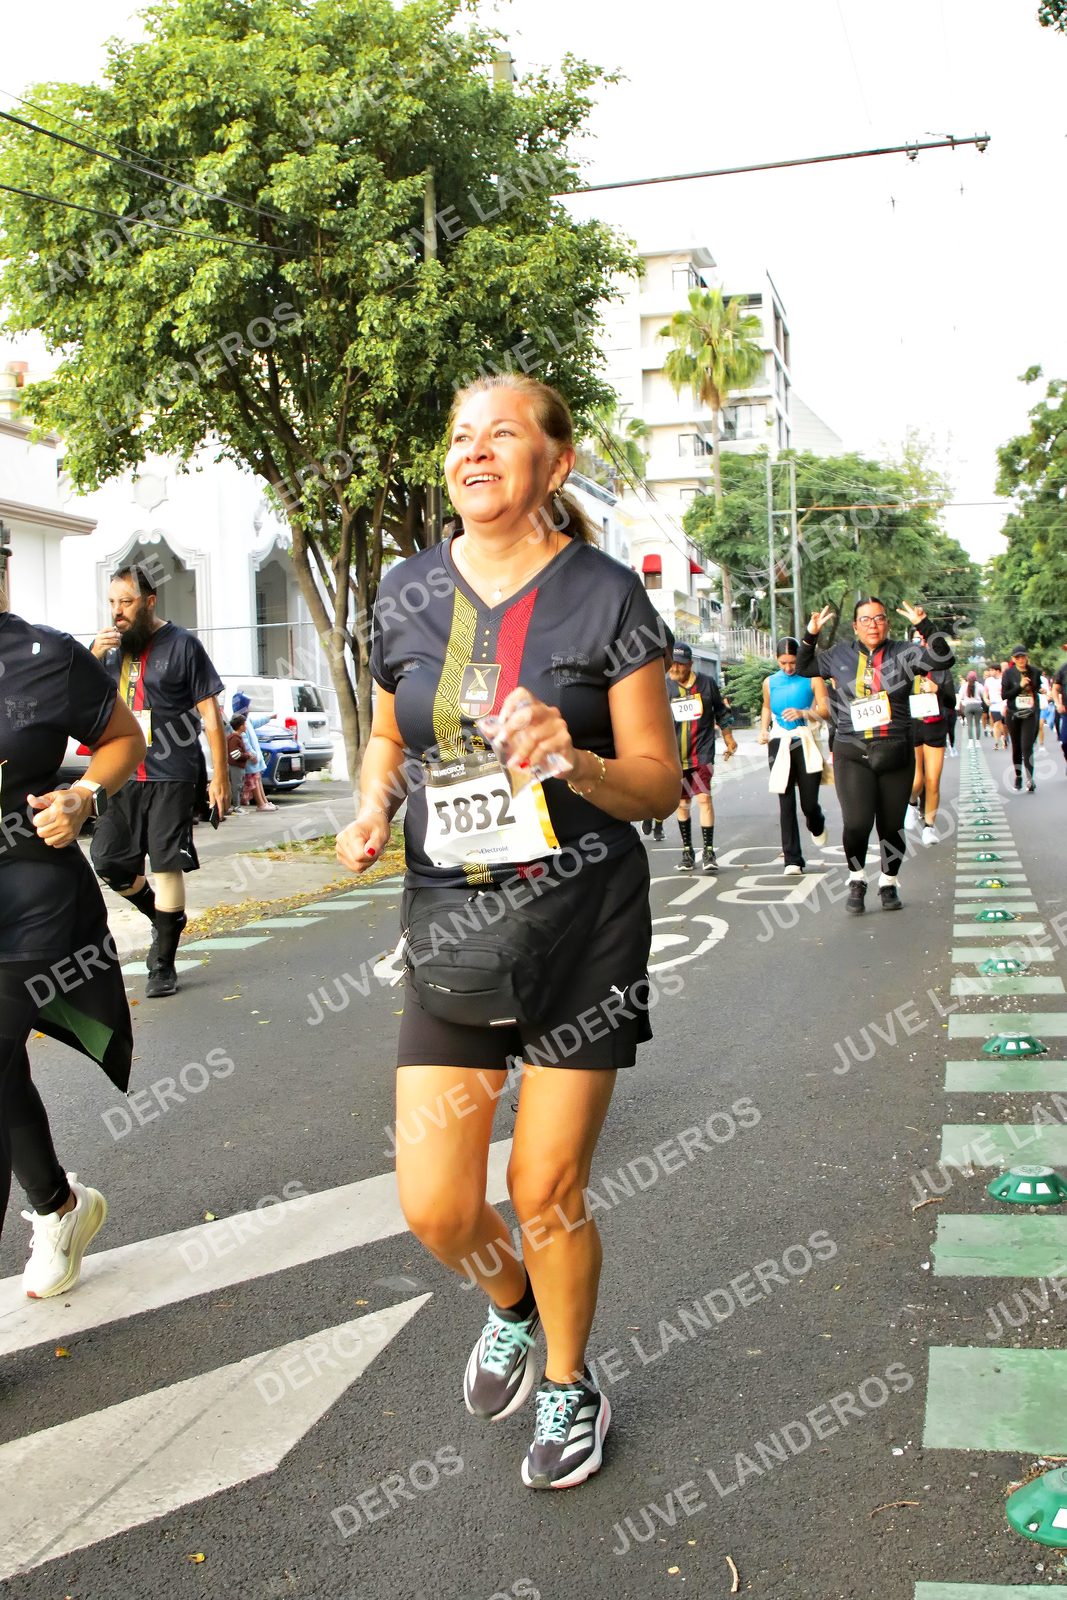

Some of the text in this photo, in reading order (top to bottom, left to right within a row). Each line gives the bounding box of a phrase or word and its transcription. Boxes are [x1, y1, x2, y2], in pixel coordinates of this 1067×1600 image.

[678, 703, 694, 713] 200
[856, 704, 882, 719] 3450
[434, 788, 517, 836] 5832
